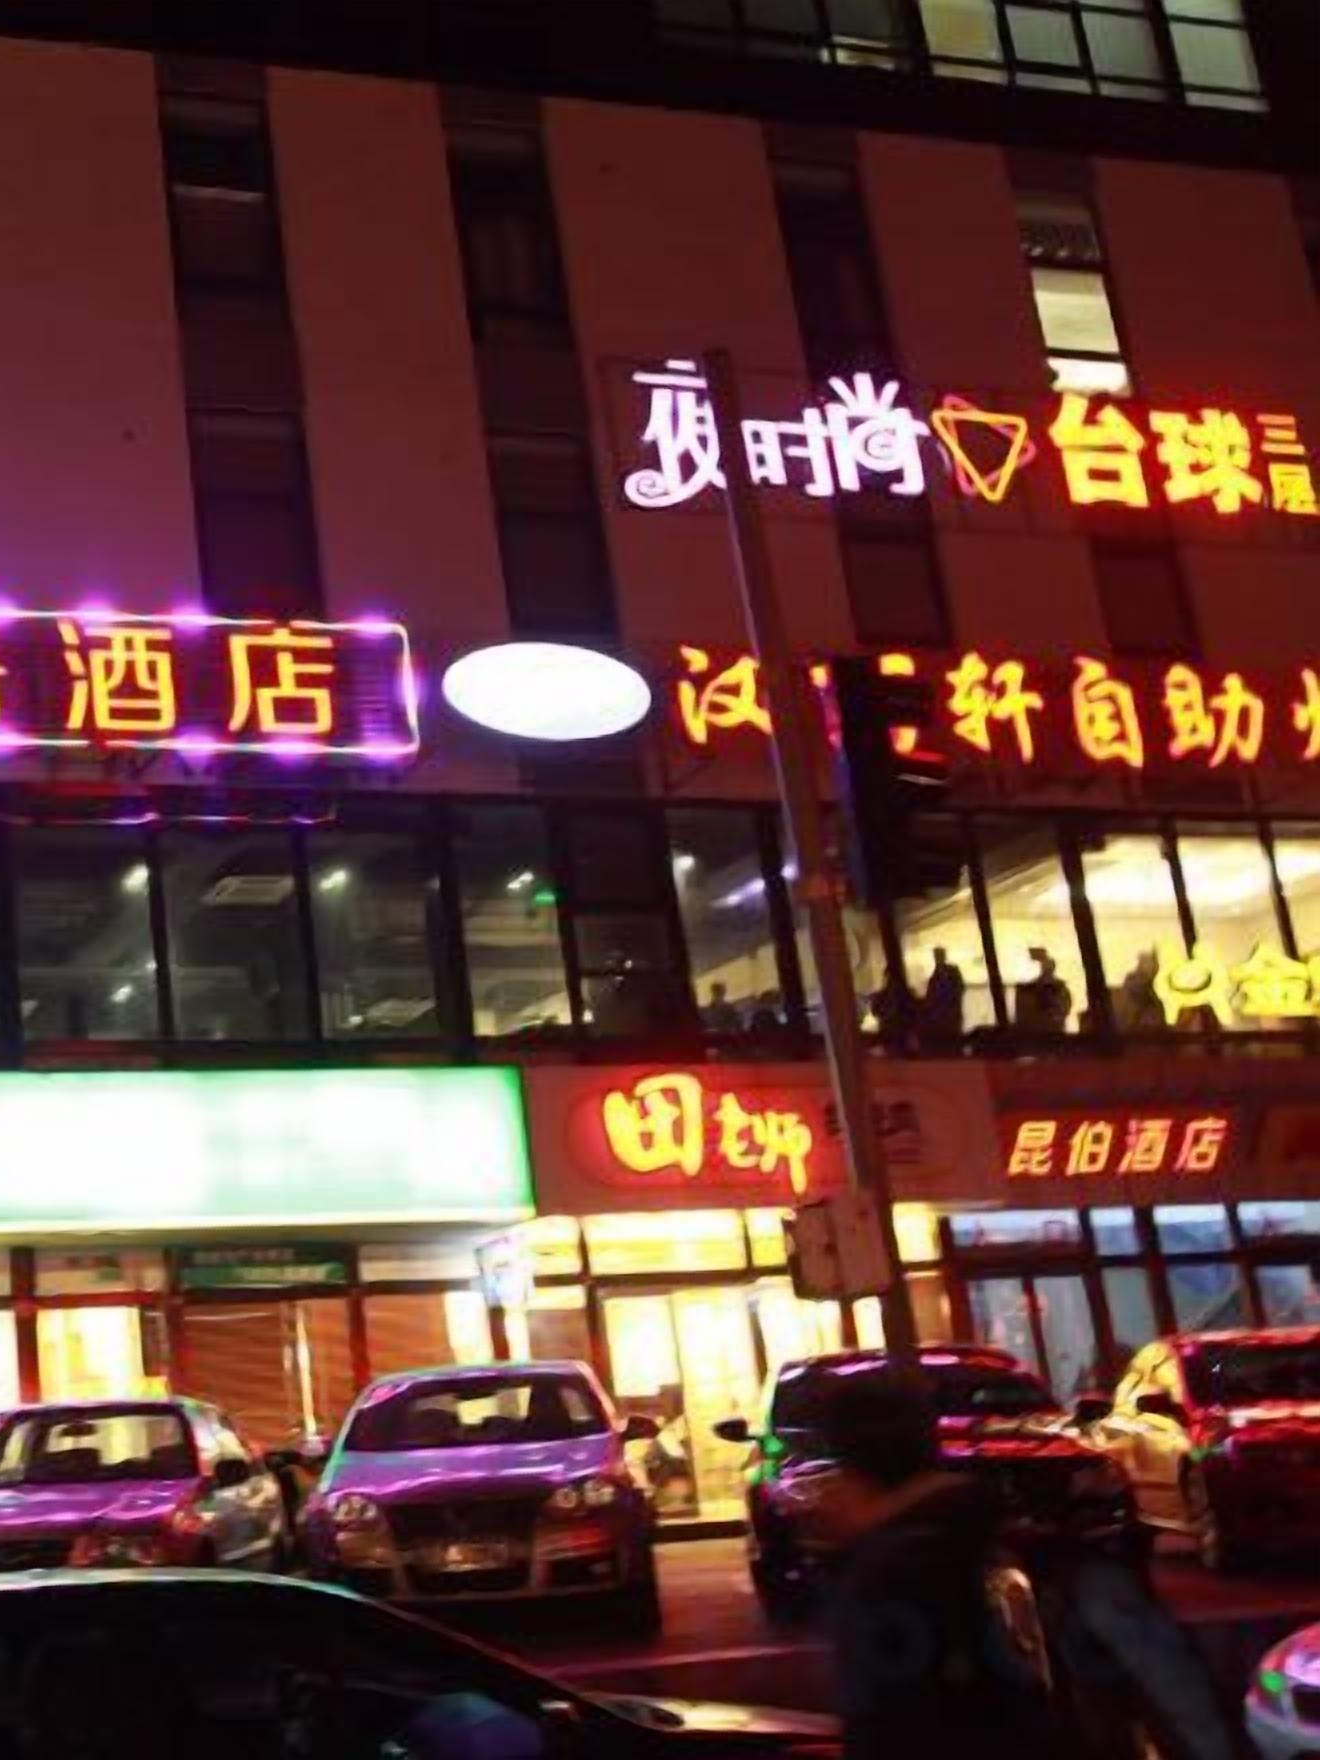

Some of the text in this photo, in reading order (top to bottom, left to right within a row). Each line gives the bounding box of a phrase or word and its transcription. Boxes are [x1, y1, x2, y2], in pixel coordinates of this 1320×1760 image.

[1048, 391, 1263, 514] 台球
[680, 645, 1320, 768] 汉轩自助
[1007, 1116, 1229, 1178] 昆伯酒店
